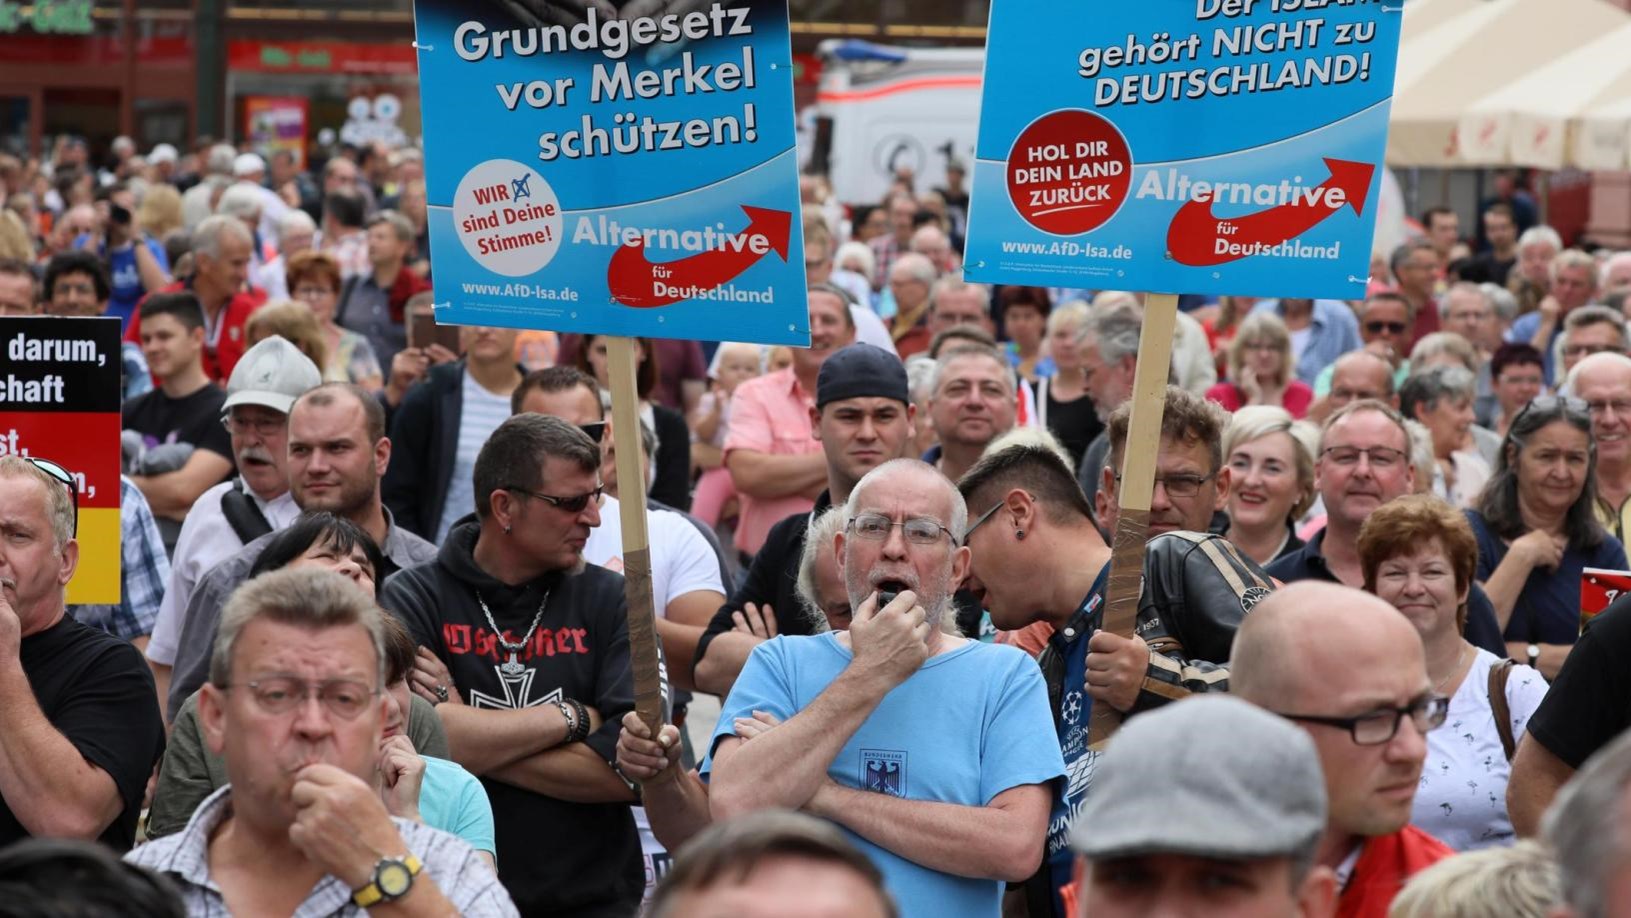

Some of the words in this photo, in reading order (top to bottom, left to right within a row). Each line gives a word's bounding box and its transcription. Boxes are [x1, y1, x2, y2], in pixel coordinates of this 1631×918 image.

[1196, 0, 1257, 18] Der
[454, 3, 752, 61] Grundgesetz
[1078, 32, 1200, 77] gehört
[1212, 19, 1325, 56] NICHT
[1334, 21, 1376, 44] zu
[496, 77, 574, 110] vor
[591, 46, 755, 103] Merkel
[1094, 53, 1371, 106] DEUTSCHLAND!
[539, 103, 757, 160] schützen!
[1028, 144, 1070, 162] HOL
[1075, 141, 1109, 158] DIR
[1015, 166, 1062, 184] DEIN
[1069, 160, 1123, 179] LAND
[473, 184, 510, 205] WIR
[1029, 182, 1111, 206] ZURÜCK
[1136, 168, 1346, 208] Alternative
[463, 210, 500, 233] sind
[503, 203, 555, 224] Deine
[1216, 221, 1239, 235] für
[478, 225, 552, 255] Stimme!
[572, 215, 770, 254] Alternative
[1214, 238, 1340, 260] Deutschland
[652, 265, 673, 279] für
[653, 281, 774, 304] Deutschland
[9, 333, 106, 367] darum,
